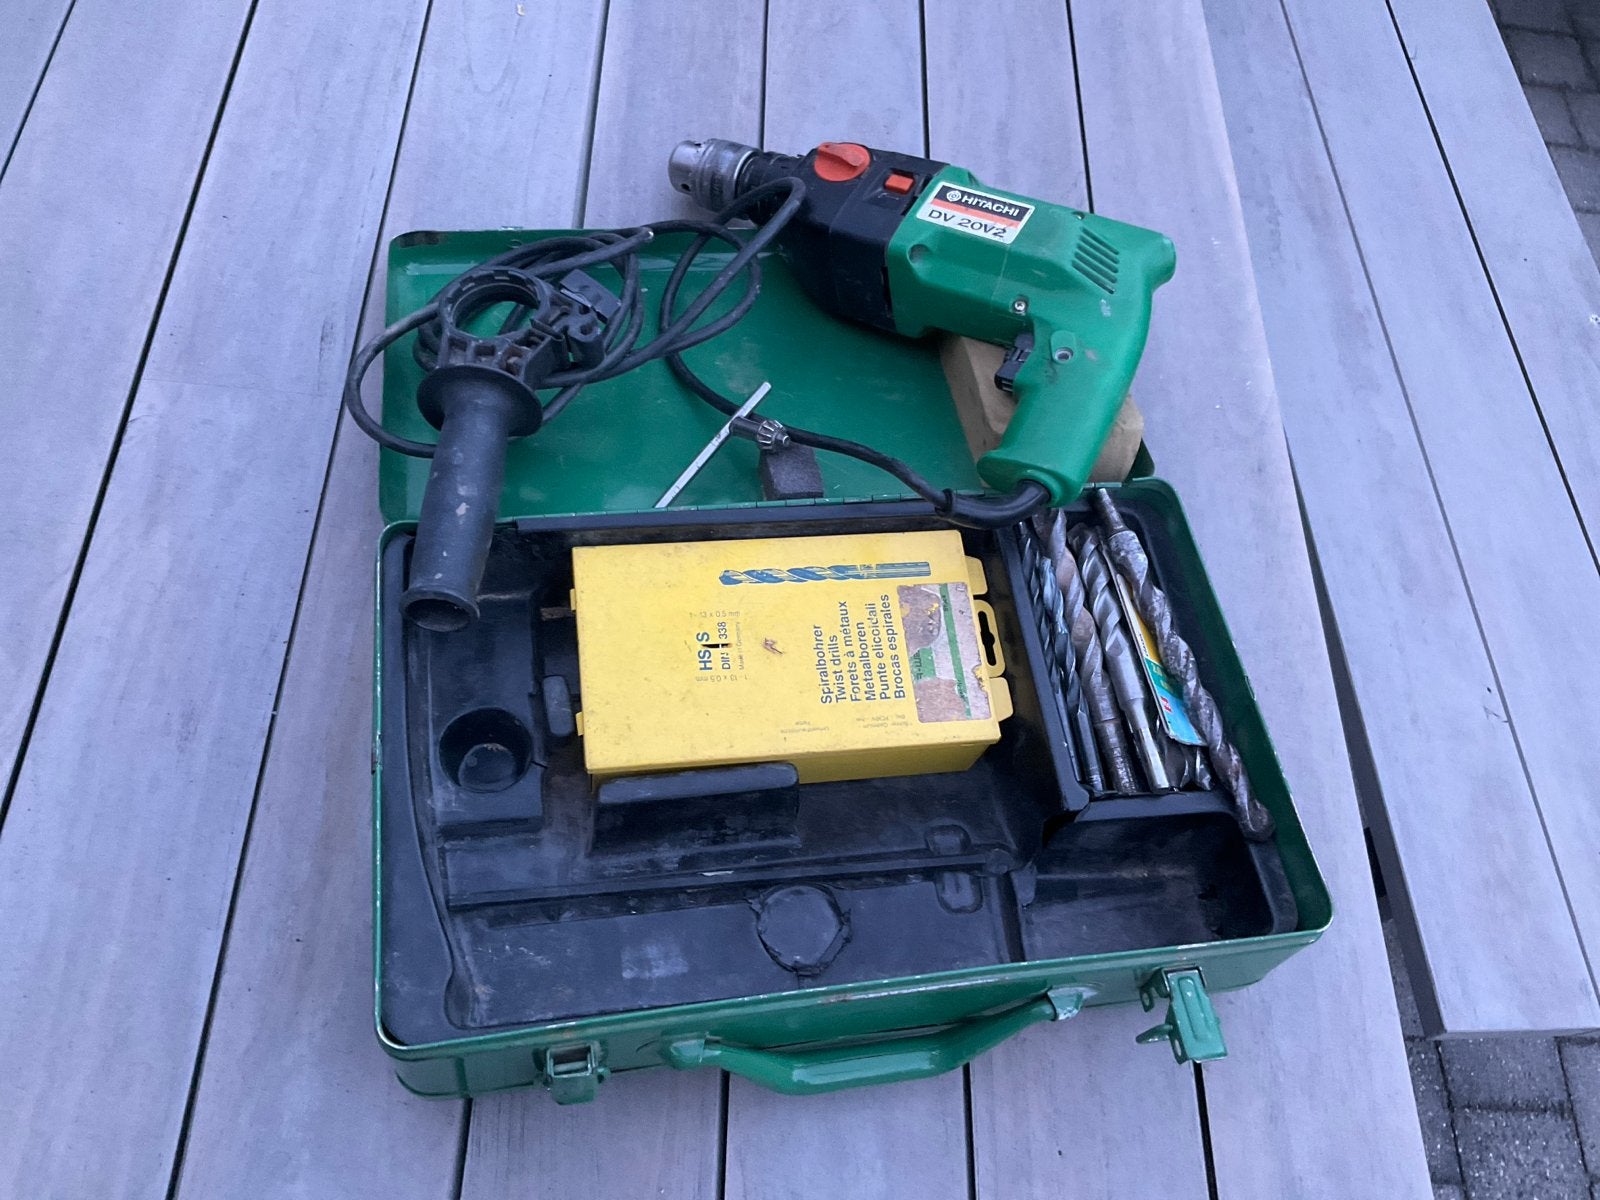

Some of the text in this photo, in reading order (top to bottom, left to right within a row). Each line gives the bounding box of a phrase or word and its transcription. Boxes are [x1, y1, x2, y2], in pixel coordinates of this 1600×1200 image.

[928, 209, 1007, 238] DV 20V2
[961, 195, 1020, 217] HITACHI
[717, 621, 728, 639] 338
[813, 624, 834, 704] Spiralbohrer
[828, 635, 847, 702] Twist drills
[839, 601, 862, 702] Forets à métaux
[856, 622, 876, 701] Metaalboren
[865, 603, 891, 700] Punte elicoidali
[880, 594, 906, 699] Brocas espirales
